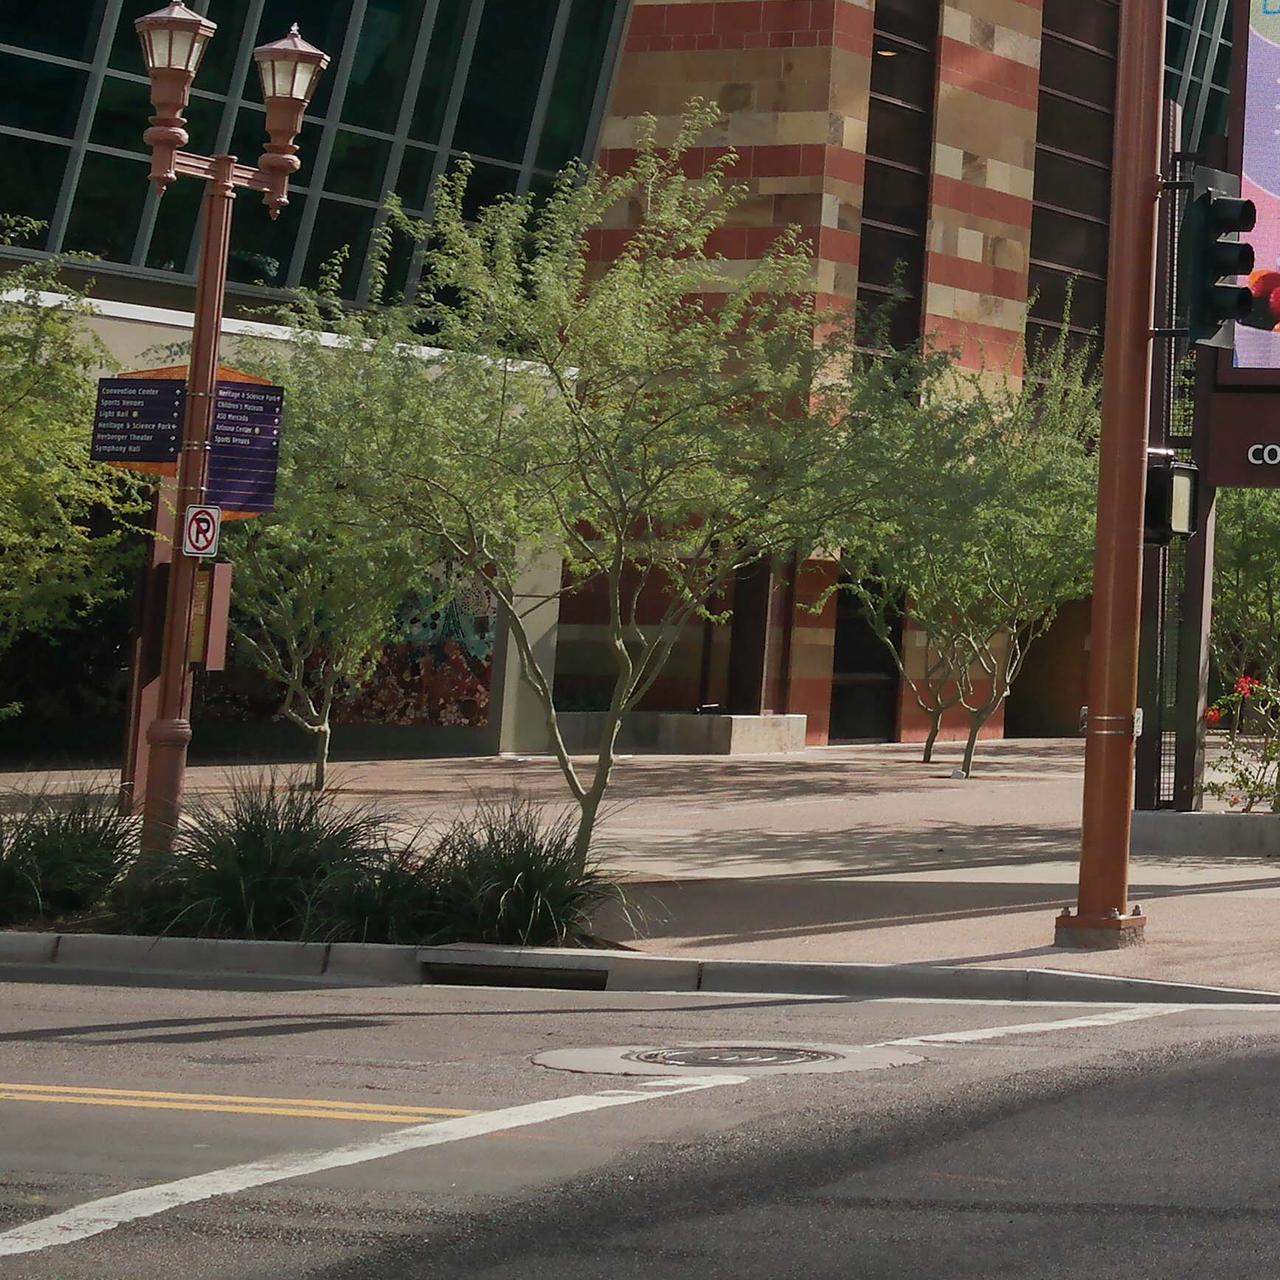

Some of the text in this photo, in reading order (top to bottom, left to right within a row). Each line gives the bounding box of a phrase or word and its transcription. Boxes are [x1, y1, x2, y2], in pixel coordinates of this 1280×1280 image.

[101, 399, 120, 407] Sports
[98, 422, 124, 430] Heritage
[95, 445, 126, 453] Symphony
